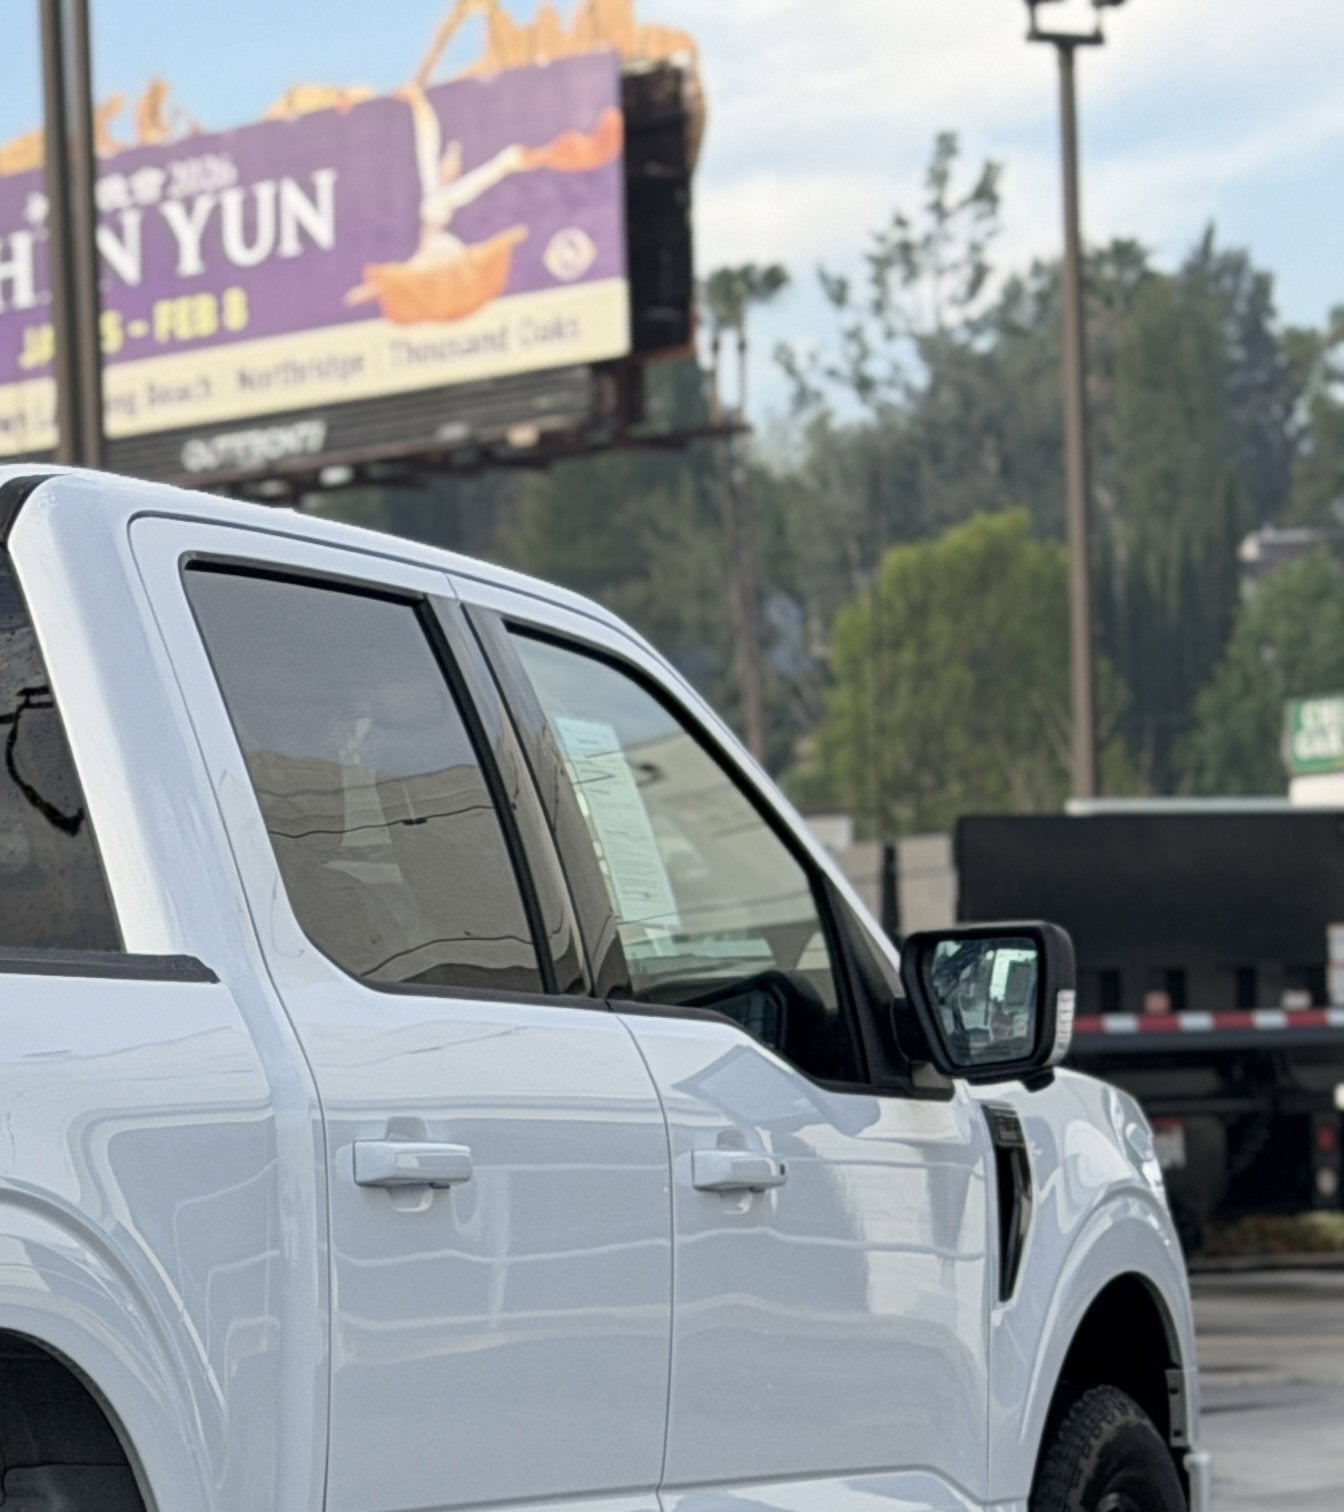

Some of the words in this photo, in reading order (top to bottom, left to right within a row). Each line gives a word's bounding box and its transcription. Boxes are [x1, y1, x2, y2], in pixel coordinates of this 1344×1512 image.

[161, 169, 337, 278] YUN
[153, 292, 218, 344] FEB
[223, 286, 248, 332] 8
